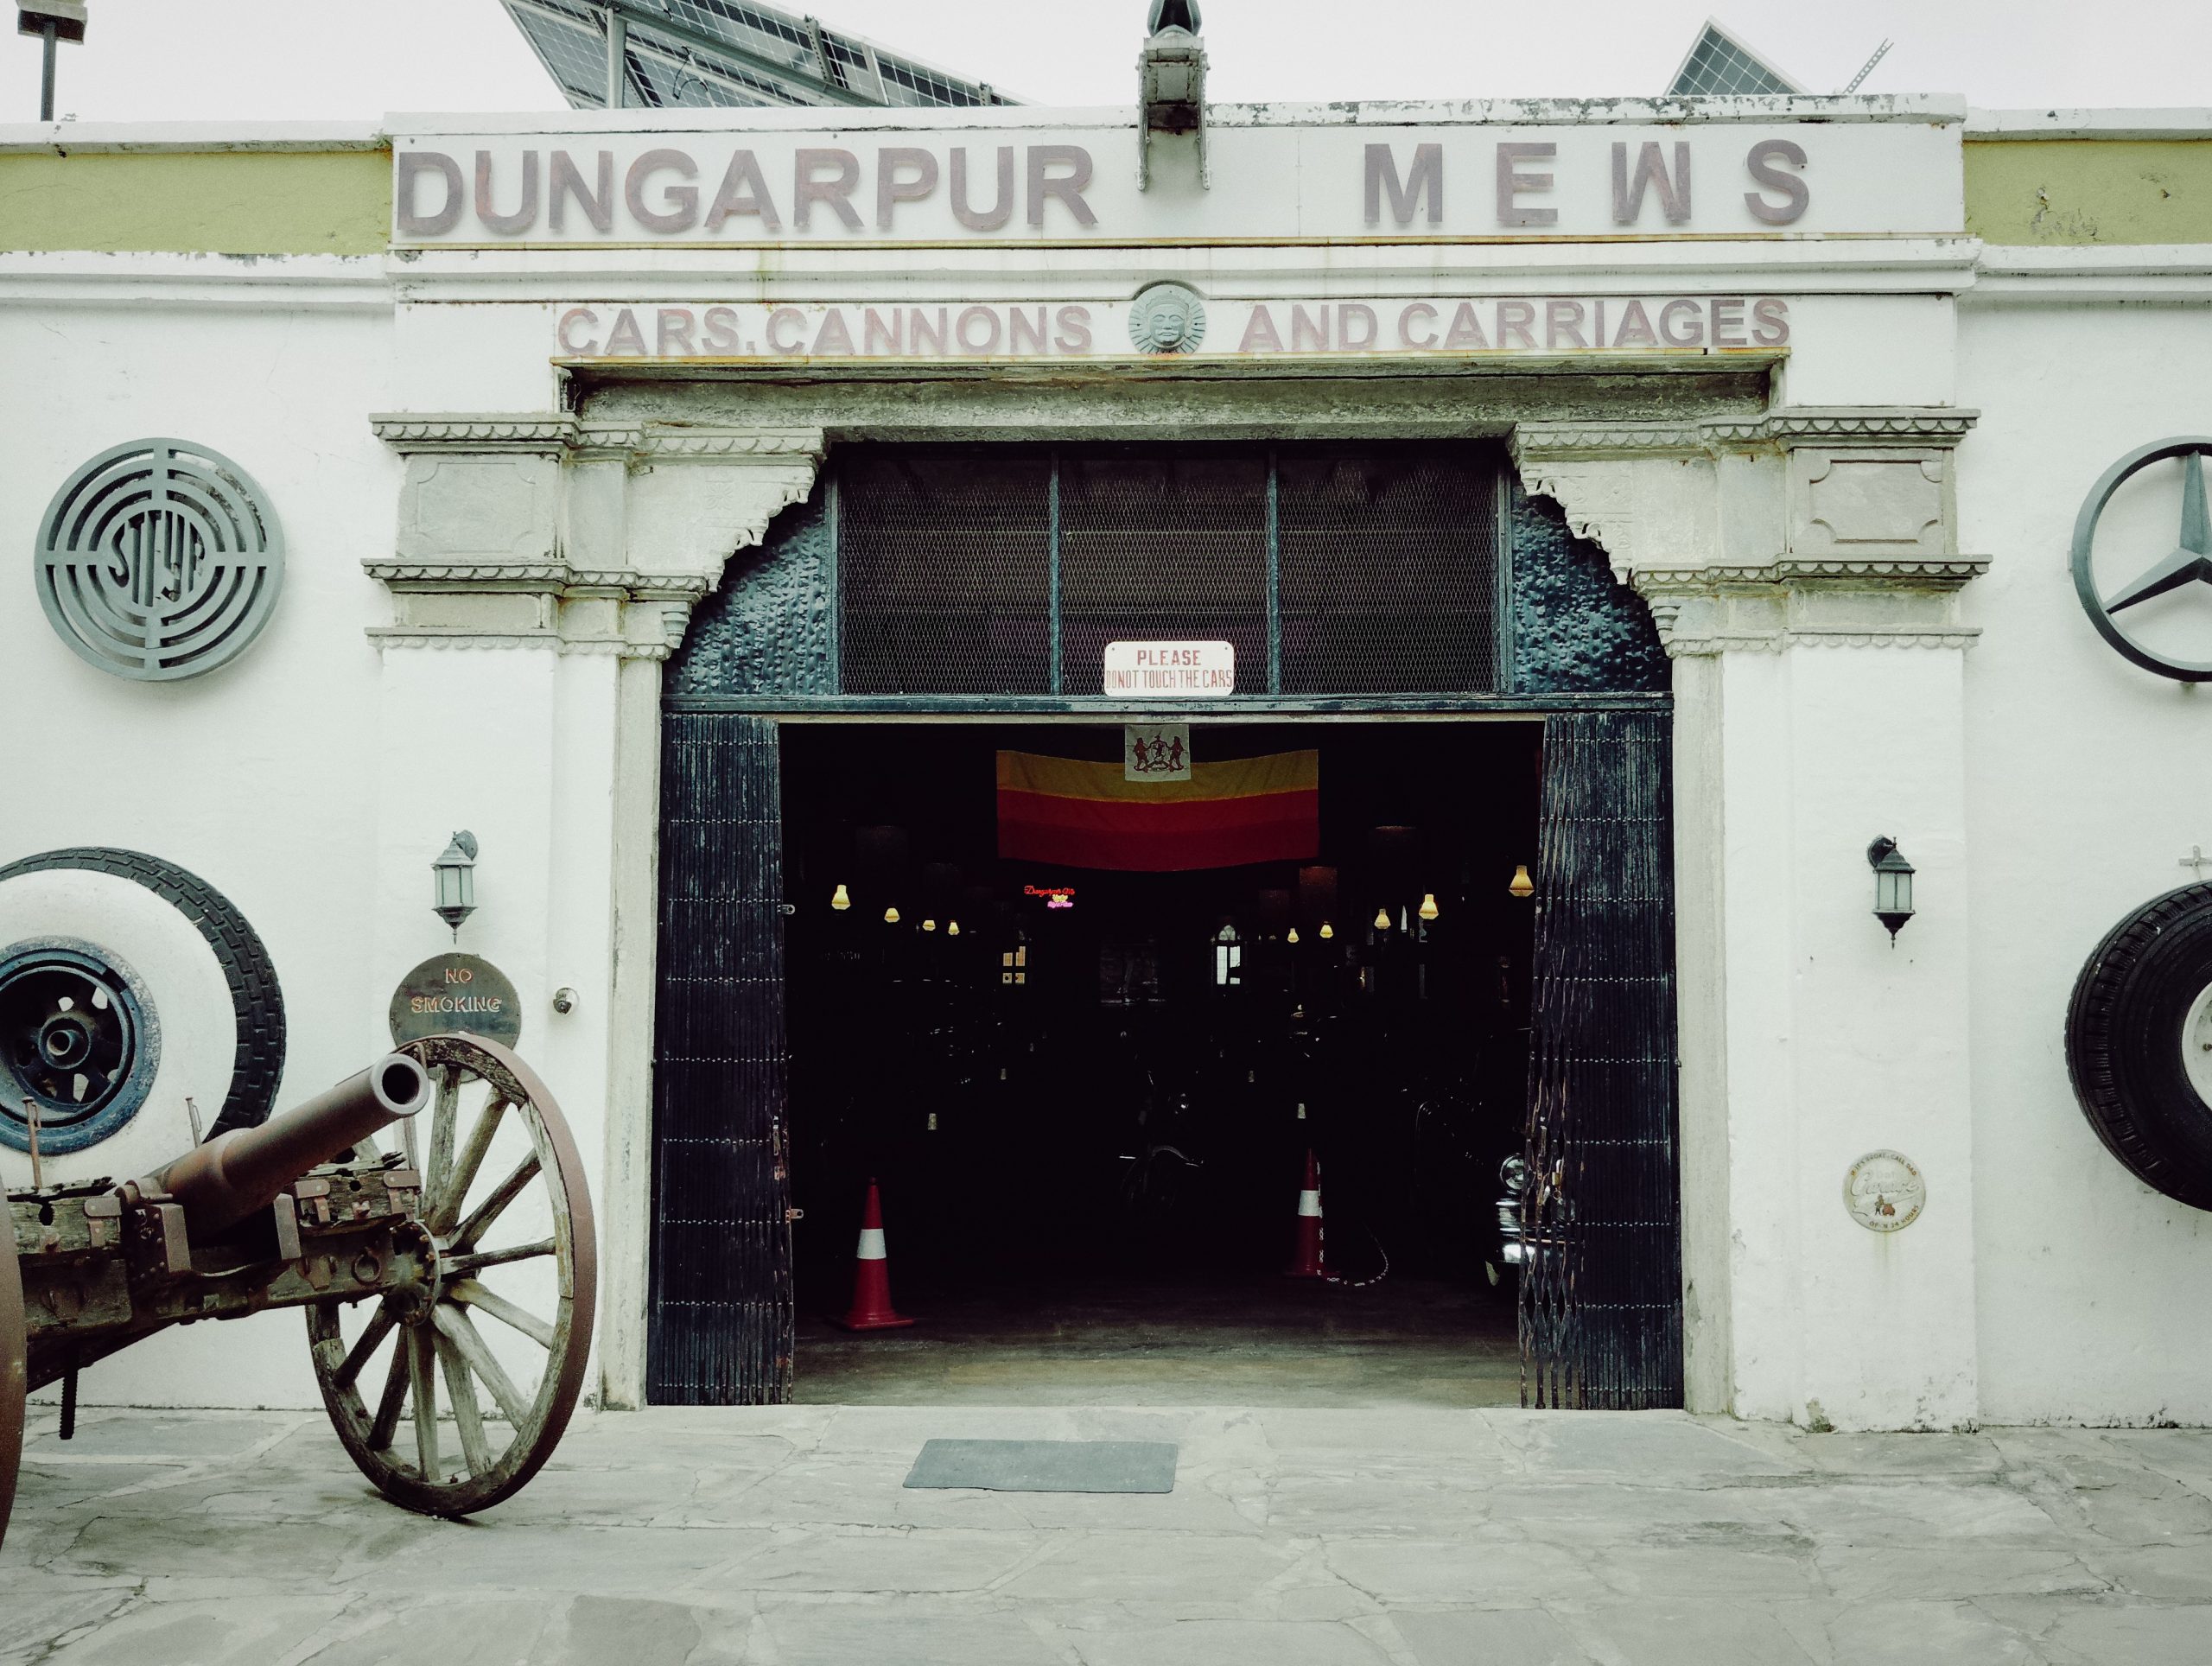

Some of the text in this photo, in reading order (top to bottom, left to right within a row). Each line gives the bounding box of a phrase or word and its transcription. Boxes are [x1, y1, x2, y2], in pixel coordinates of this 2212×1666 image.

[397, 138, 1809, 234] DUNGARPUR MEWS
[1238, 303, 1377, 352] AND
[1398, 298, 1791, 347] CARRIAGES
[1137, 650, 1201, 665] PLEASE
[1142, 671, 1175, 688] TOUCH
[1179, 670, 1199, 688] THE
[1203, 670, 1232, 688] CARS
[445, 968, 474, 983] NO
[411, 996, 502, 1013] SMOKING
